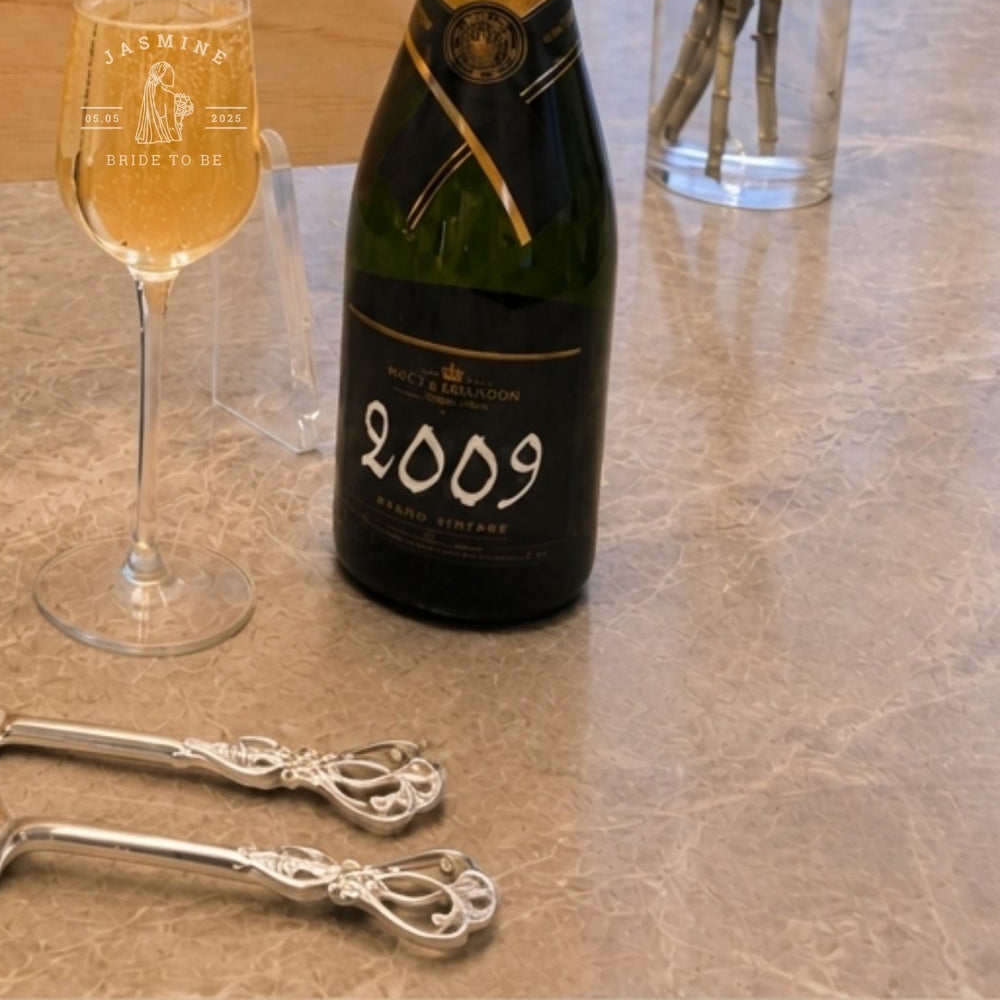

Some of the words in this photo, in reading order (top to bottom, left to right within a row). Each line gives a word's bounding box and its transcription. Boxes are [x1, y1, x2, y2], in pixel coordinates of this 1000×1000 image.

[104, 34, 228, 66] JASMINE
[85, 113, 120, 123] 05.05
[211, 113, 242, 123] 2025
[107, 154, 161, 167] BRIDE
[169, 154, 192, 167] TO
[201, 154, 223, 167] BE
[361, 400, 543, 510] 2009
